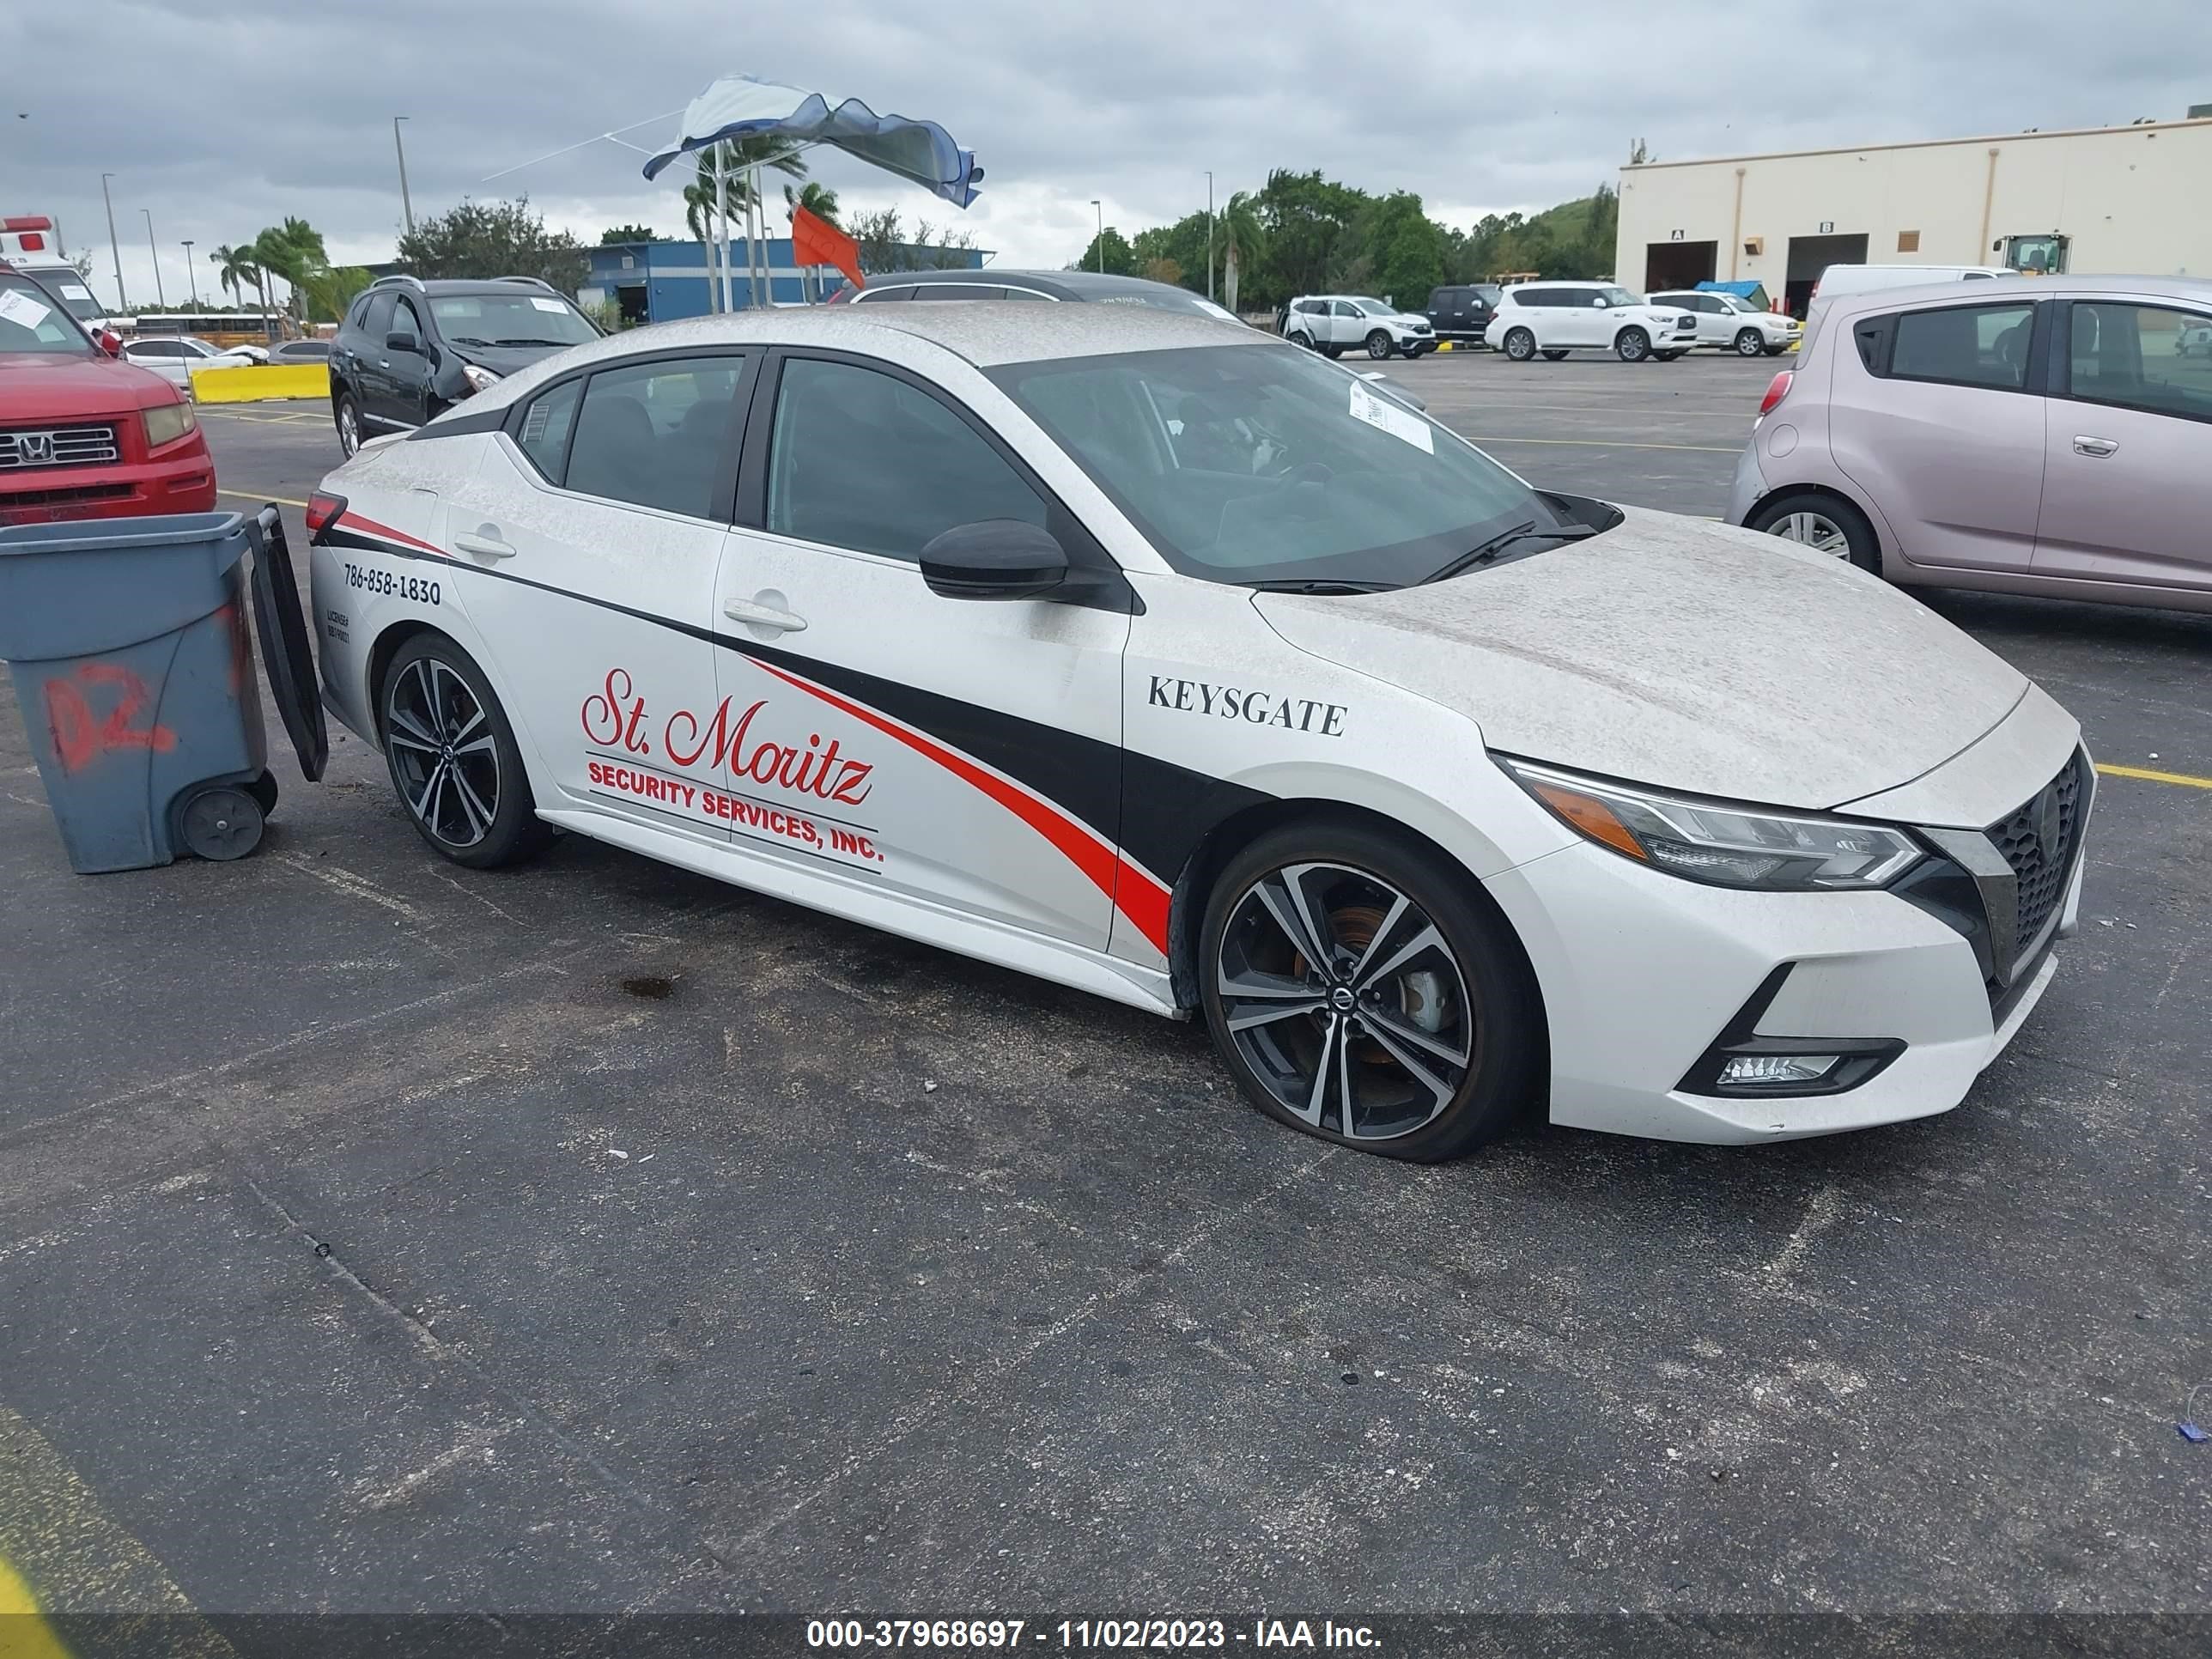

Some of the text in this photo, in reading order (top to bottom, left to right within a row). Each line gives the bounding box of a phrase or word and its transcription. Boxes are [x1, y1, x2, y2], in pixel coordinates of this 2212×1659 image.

[1674, 230, 1682, 240] A
[1822, 222, 1832, 233] B
[345, 563, 441, 605] 786-858-1830
[1148, 675, 1348, 737] KEYSGATE
[581, 668, 873, 805] St. Moritz
[588, 762, 884, 862] SECURITY SERVICES, INC.
